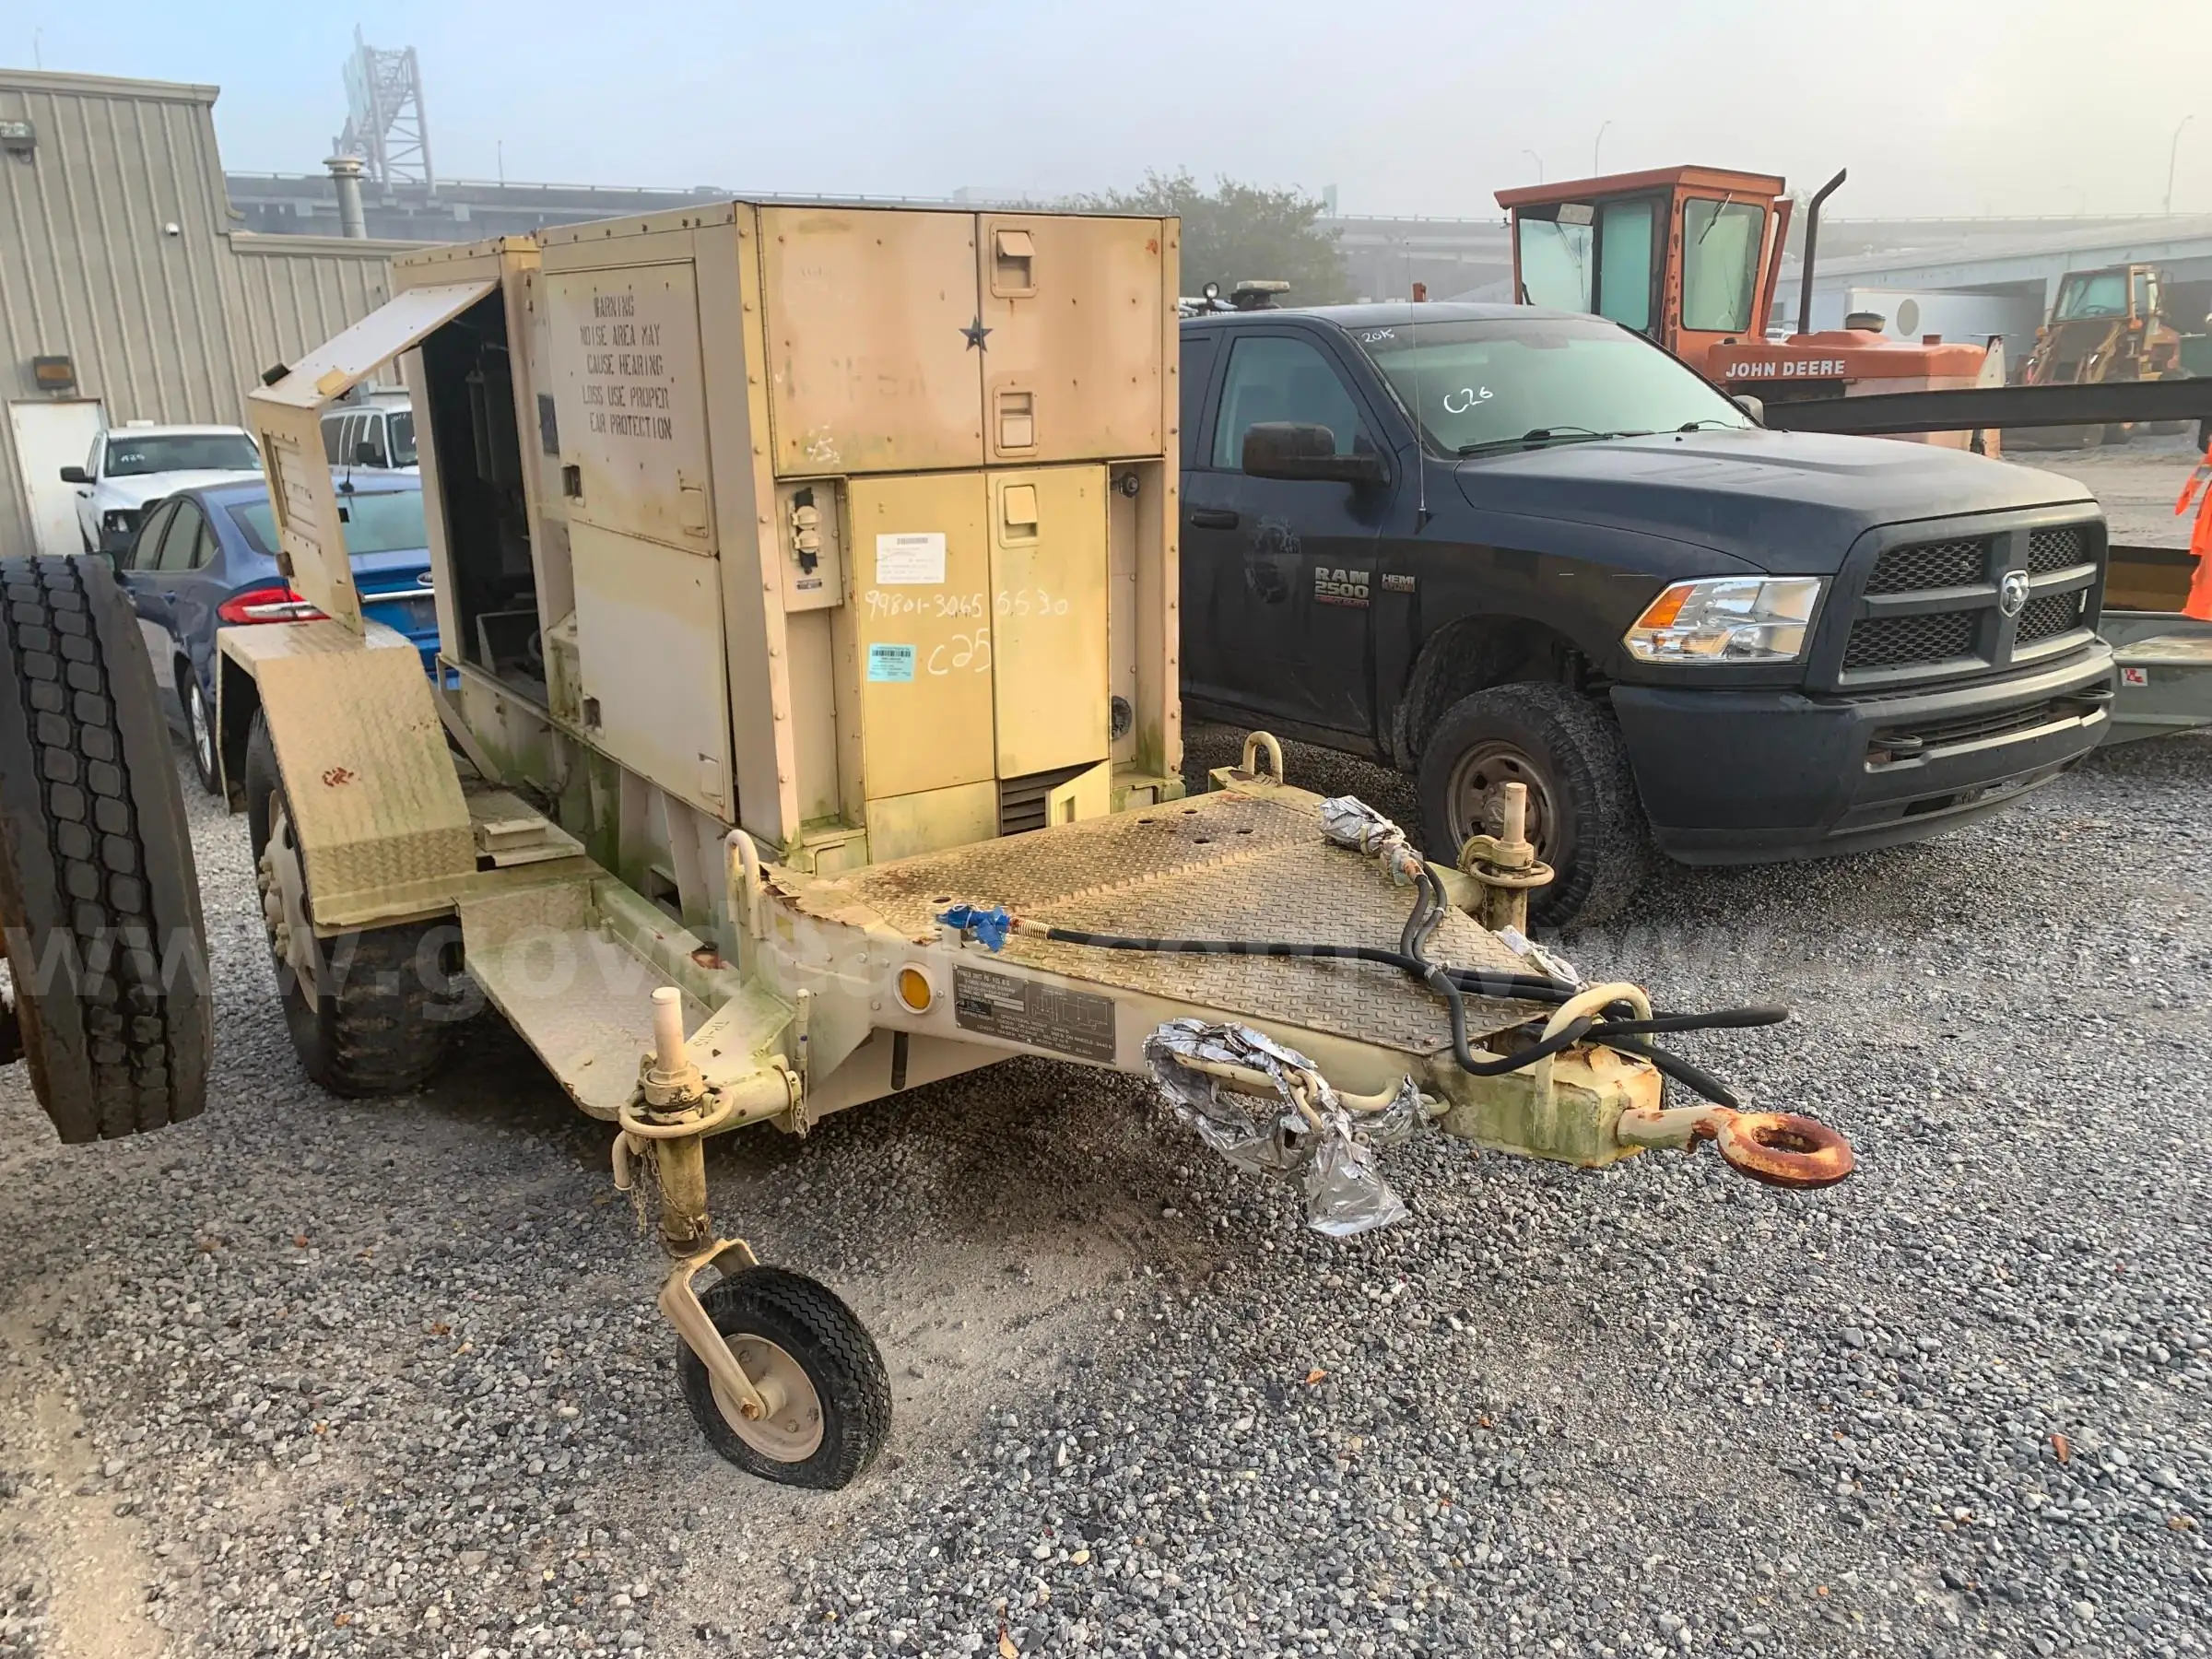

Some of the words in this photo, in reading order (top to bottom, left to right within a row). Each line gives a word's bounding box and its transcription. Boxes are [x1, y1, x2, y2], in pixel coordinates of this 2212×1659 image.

[594, 295, 635, 318] WARNING
[579, 324, 607, 347] NOISE
[612, 324, 636, 347] AREA
[641, 324, 661, 347] MAY
[586, 354, 615, 376] CAUSE
[618, 354, 664, 376] HEARING
[1725, 362, 1776, 378] JOHN
[1783, 359, 1846, 376] DEERE
[582, 384, 604, 406] LOSS
[607, 385, 626, 407] USE
[629, 387, 670, 410] PROPER
[1443, 386, 1494, 414] C26
[589, 412, 606, 433] EAR
[609, 414, 673, 441] PROTECTION
[1314, 567, 1370, 584] RAM
[1382, 573, 1416, 584] HEMI
[1314, 581, 1370, 599] 2500
[927, 628, 992, 676] C25
